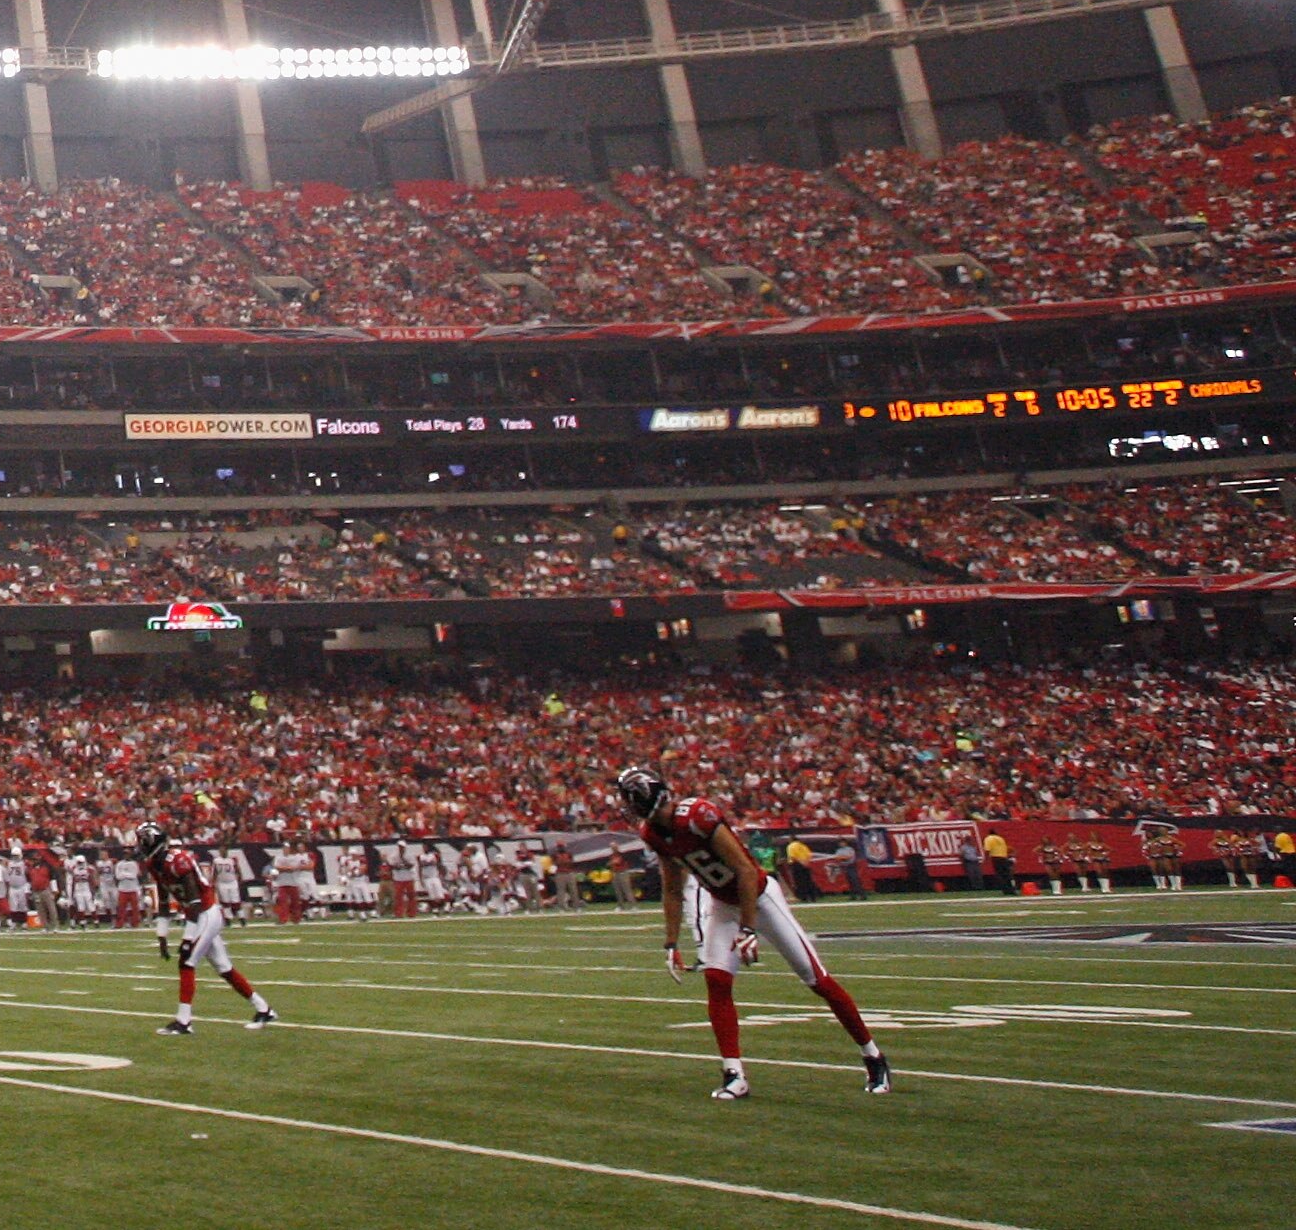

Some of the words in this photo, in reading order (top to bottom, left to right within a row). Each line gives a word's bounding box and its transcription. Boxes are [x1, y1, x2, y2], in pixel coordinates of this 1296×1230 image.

[1122, 291, 1225, 312] FALCONS
[379, 329, 465, 339] FALCONS
[1165, 389, 1178, 406] 2
[1190, 379, 1262, 398] CARDINALS
[1057, 387, 1116, 411] 10:05
[1129, 392, 1152, 408] 22
[888, 400, 913, 421] 10
[130, 419, 308, 435] GEORGIAPOWER.COM
[317, 417, 380, 436] Falcons
[552, 415, 578, 430] 174
[895, 588, 992, 601] FALCONS
